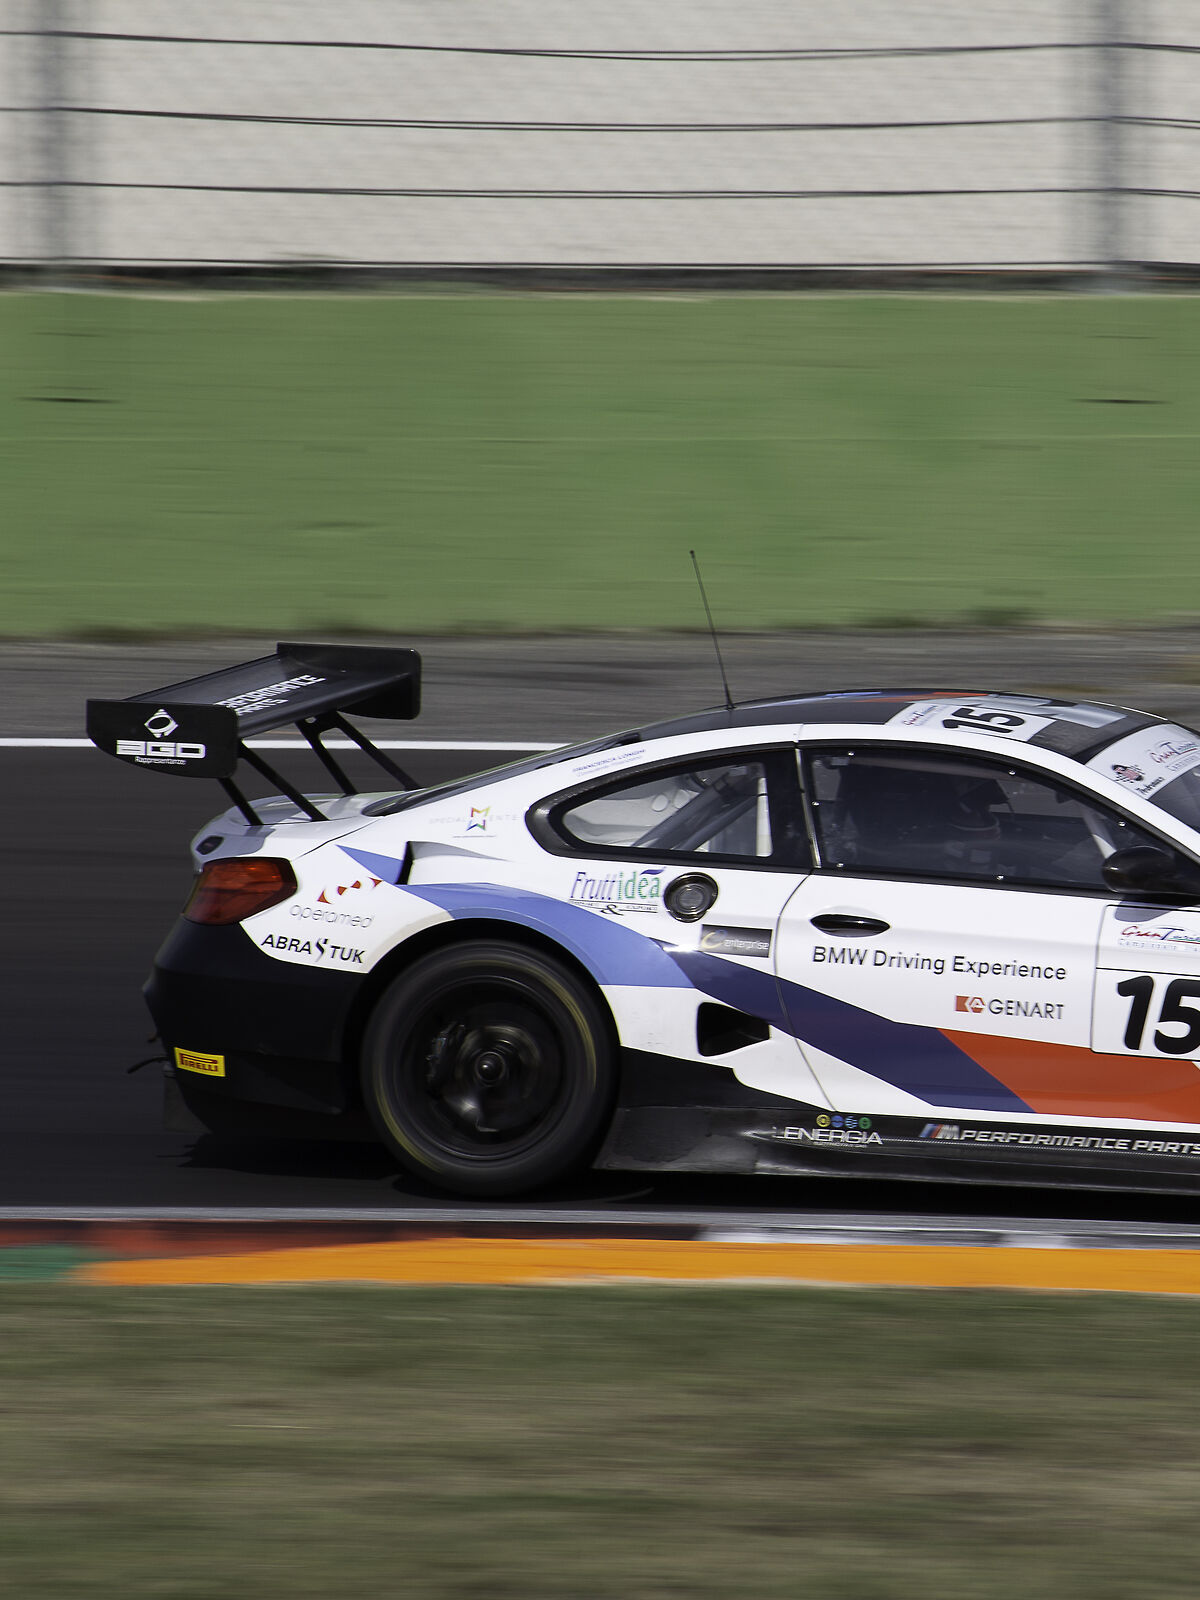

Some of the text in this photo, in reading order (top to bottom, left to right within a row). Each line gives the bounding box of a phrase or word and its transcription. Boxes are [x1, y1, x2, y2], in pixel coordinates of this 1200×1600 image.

[942, 707, 1026, 734] 15
[812, 945, 1068, 981] BMW Driving Experience
[988, 997, 1065, 1020] GENART
[179, 1053, 219, 1072] PIRELLI
[784, 1126, 883, 1145] ENERGIA
[960, 1130, 1132, 1151] PERFORMANCE
